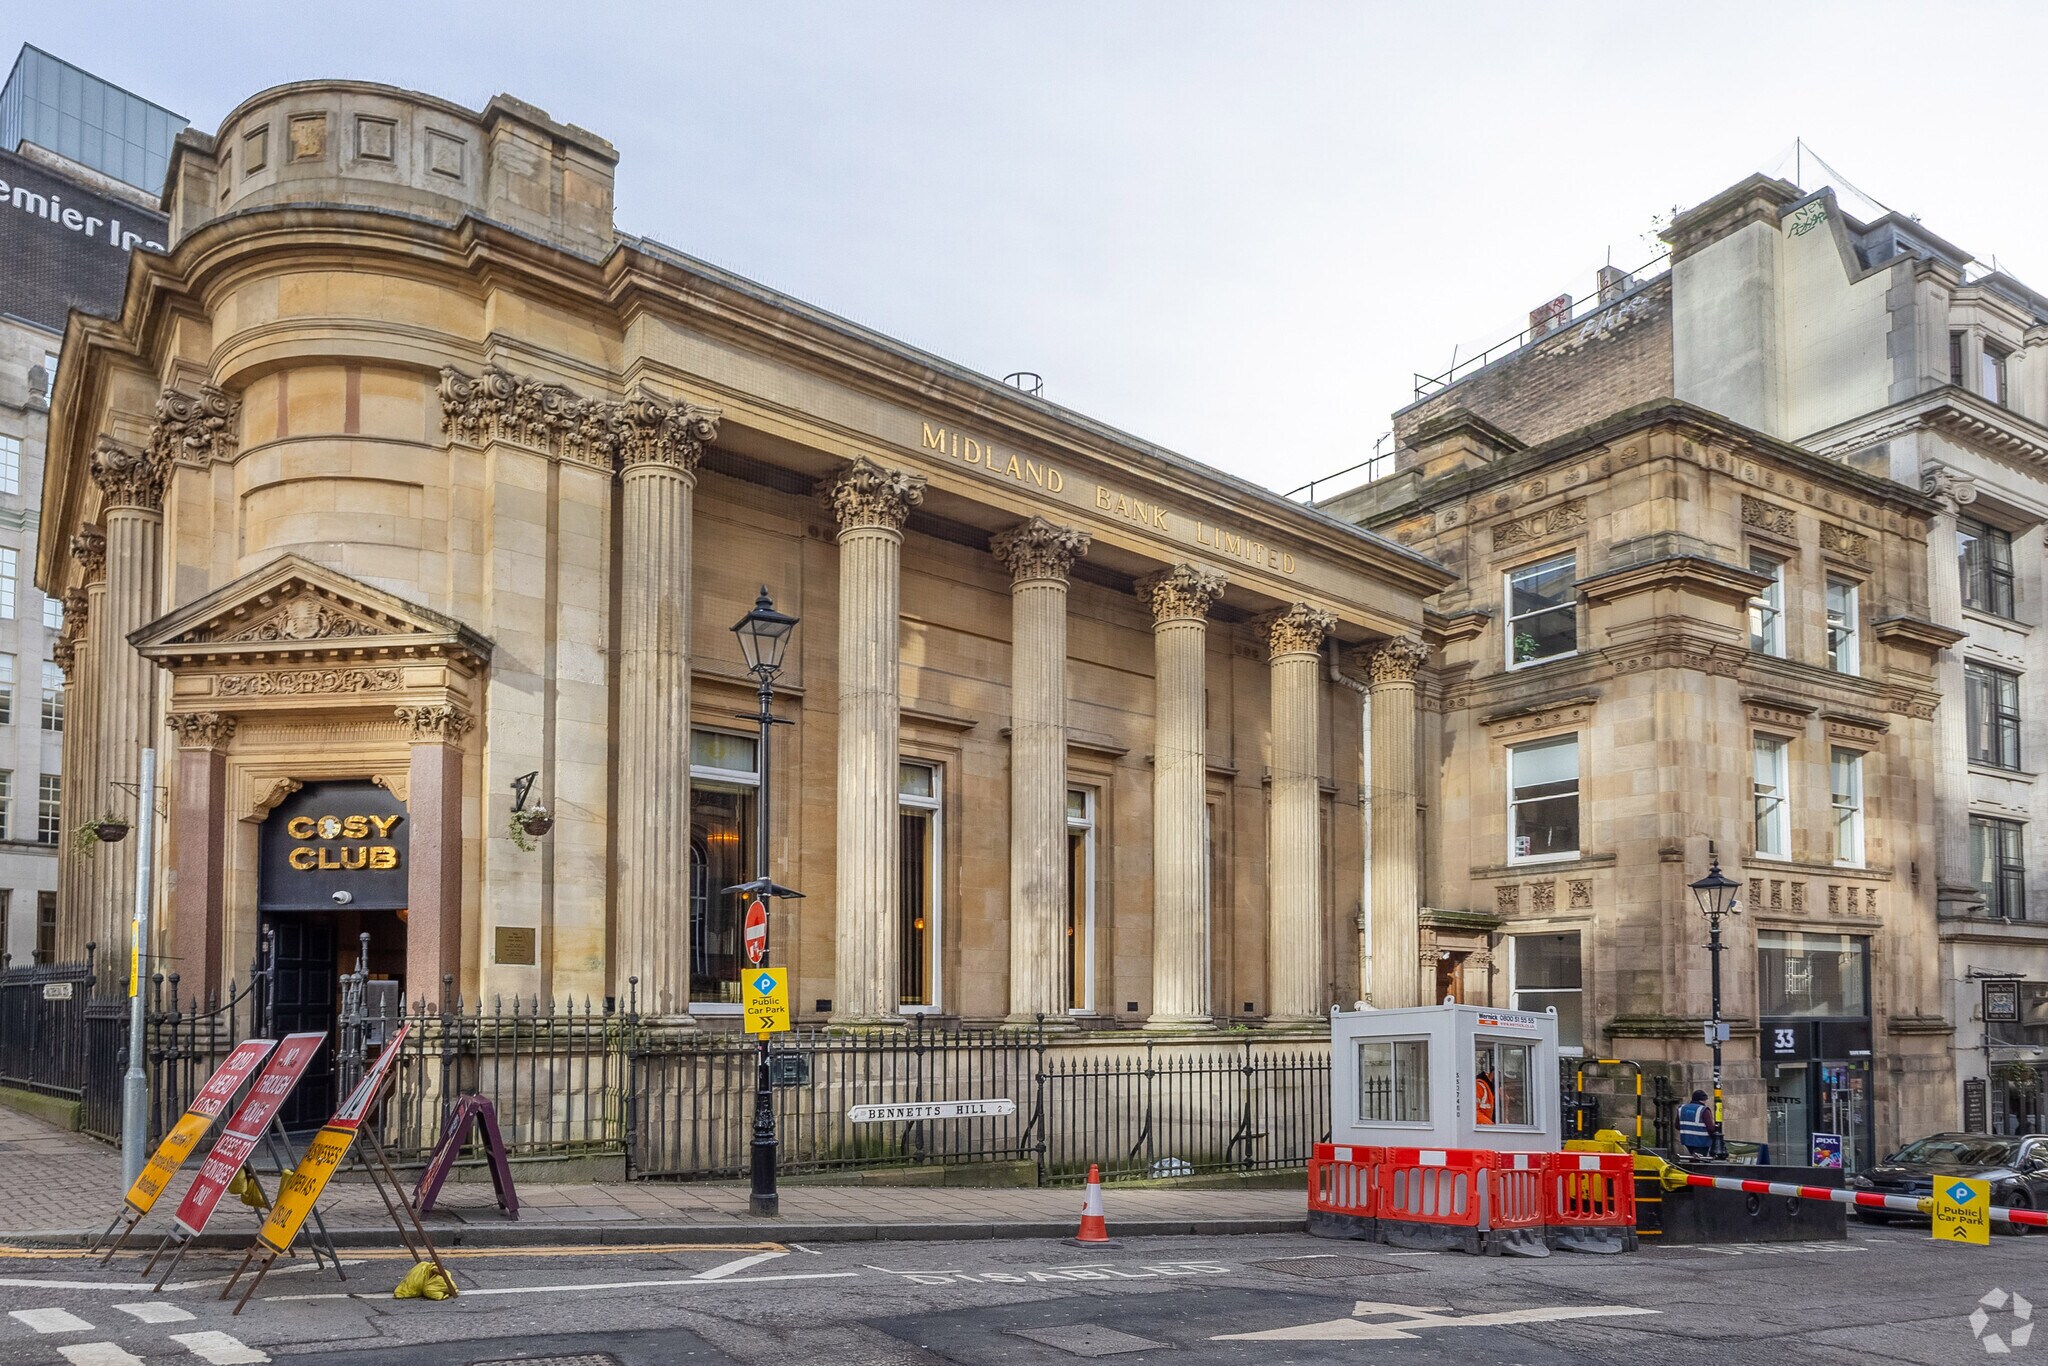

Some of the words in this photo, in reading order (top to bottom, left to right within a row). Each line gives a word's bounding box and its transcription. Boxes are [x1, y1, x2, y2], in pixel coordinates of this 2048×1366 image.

[921, 422, 1063, 494] MIDLAND
[1095, 485, 1168, 532] BANK
[1196, 522, 1296, 575] LIMITED
[287, 814, 400, 840] COSY
[288, 846, 397, 871] CLUB
[747, 1007, 763, 1015] Car
[765, 1006, 785, 1014] Park
[752, 998, 780, 1006] Public
[1500, 1014, 1513, 1022] 0800
[1774, 1028, 1795, 1049] 33
[226, 1051, 256, 1070] ROAD
[283, 1047, 300, 1067] NO
[208, 1074, 238, 1095] AHEAD
[256, 1074, 293, 1095] THROUGH
[1768, 1095, 1802, 1105] NETTS
[240, 1099, 271, 1123] ROUTE
[868, 1106, 941, 1119] BENNETTS
[956, 1104, 987, 1114] HILL
[213, 1135, 243, 1158] ACCESS
[234, 1141, 251, 1160] TO
[1816, 1137, 1839, 1145] PIXL
[304, 1142, 343, 1166] BUSINESSES
[200, 1157, 235, 1186] FRONTAGES
[192, 1183, 213, 1207] ONLY
[288, 1173, 309, 1193] OPEN
[301, 1177, 316, 1196] AS
[271, 1204, 293, 1229] USUAL
[1937, 1213, 1957, 1222] Car
[1959, 1215, 1984, 1226] Park
[1944, 1206, 1978, 1217] Public
[901, 1263, 1231, 1285] DISABLED
